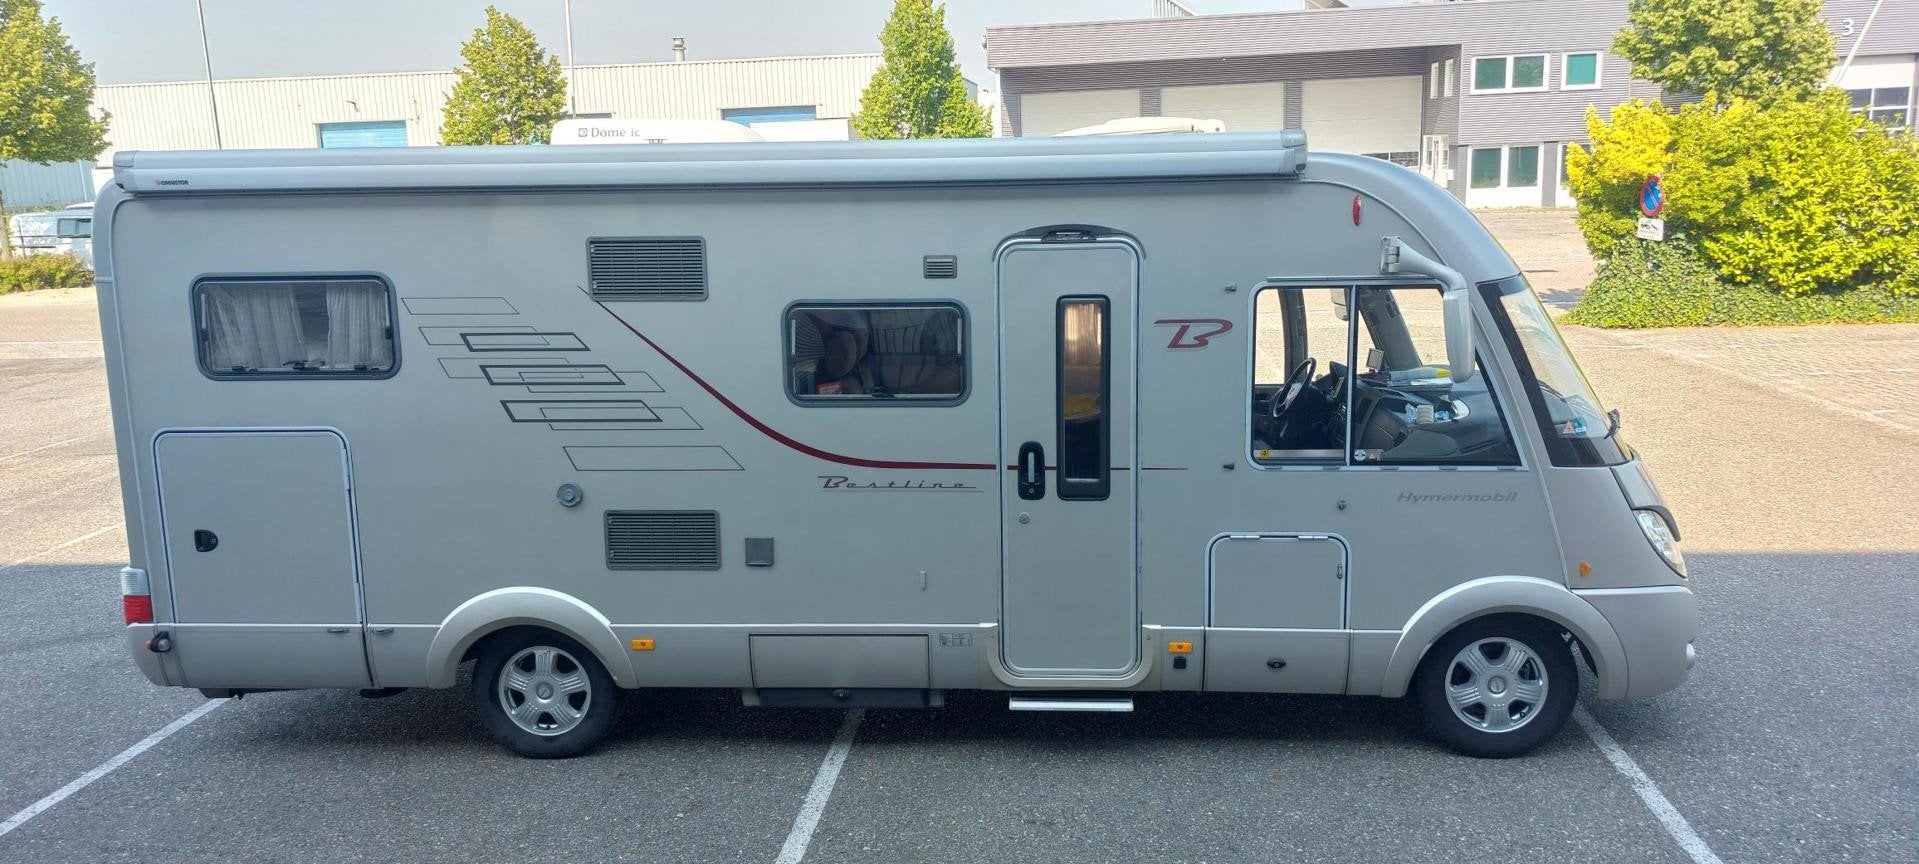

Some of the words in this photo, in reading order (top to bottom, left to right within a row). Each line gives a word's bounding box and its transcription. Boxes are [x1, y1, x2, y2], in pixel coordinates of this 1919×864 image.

[1840, 18, 1855, 37] 3
[591, 127, 640, 138] Domeic
[817, 475, 977, 489] Bestline
[1397, 491, 1518, 504] Hymermobil
